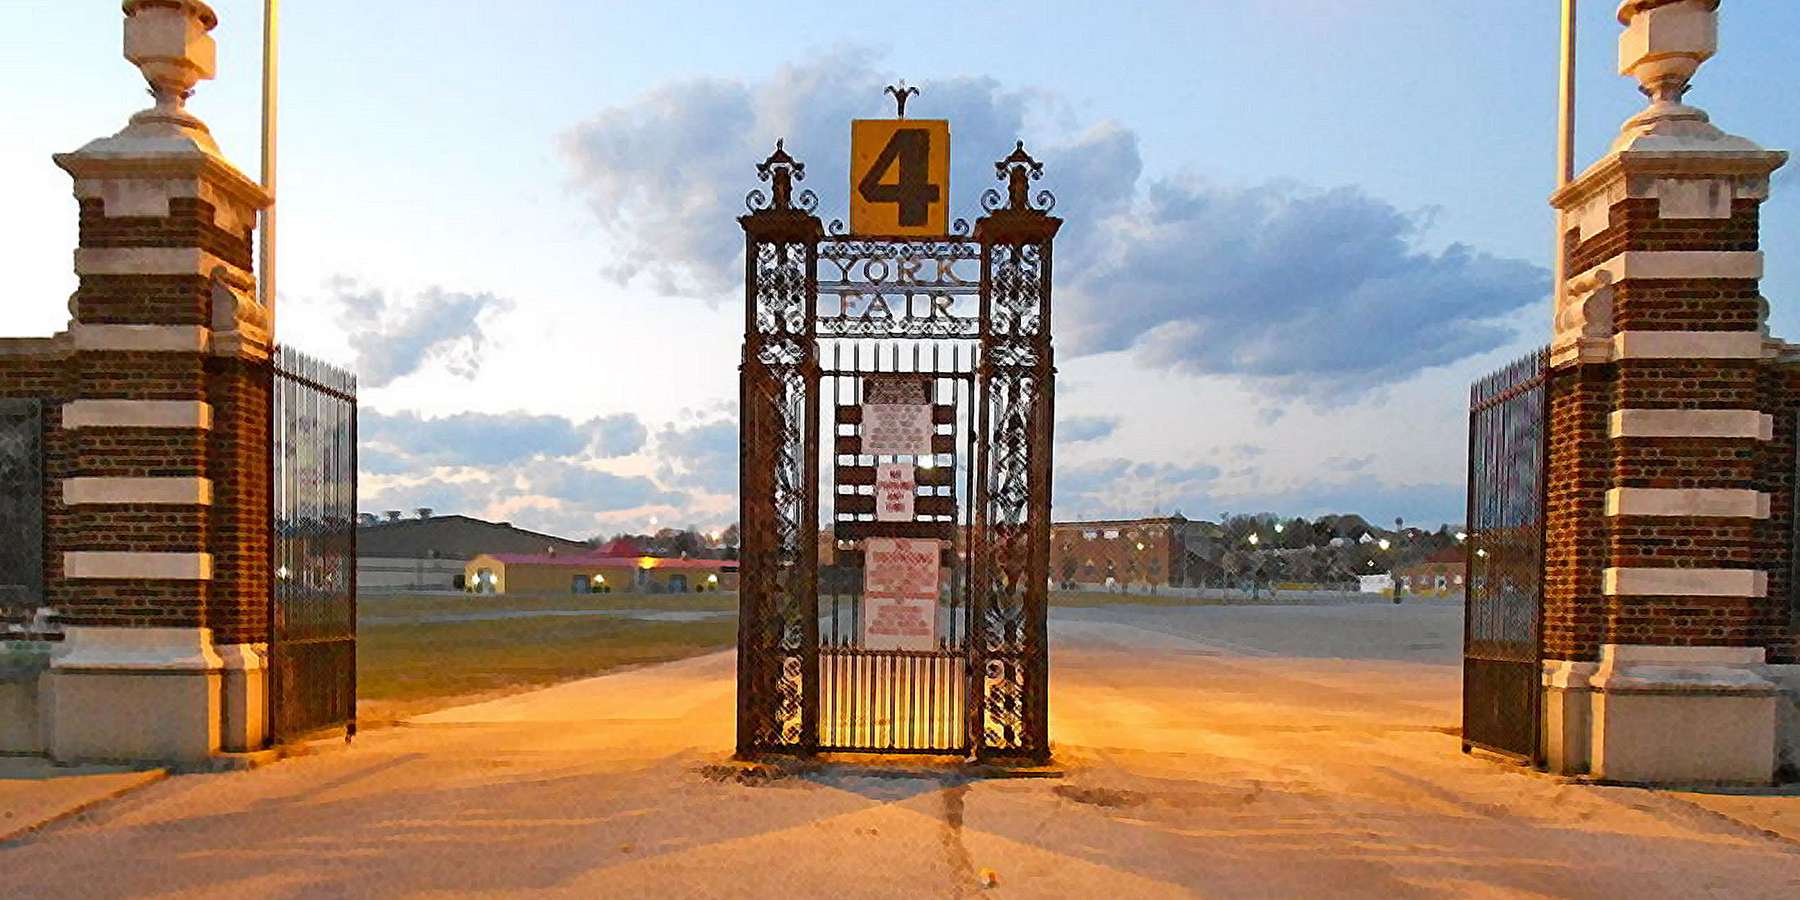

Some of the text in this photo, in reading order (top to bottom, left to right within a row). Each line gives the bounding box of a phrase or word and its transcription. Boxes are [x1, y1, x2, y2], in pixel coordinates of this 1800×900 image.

[859, 129, 940, 227] 4
[832, 256, 966, 286] YORK
[841, 290, 957, 320] FAIR
